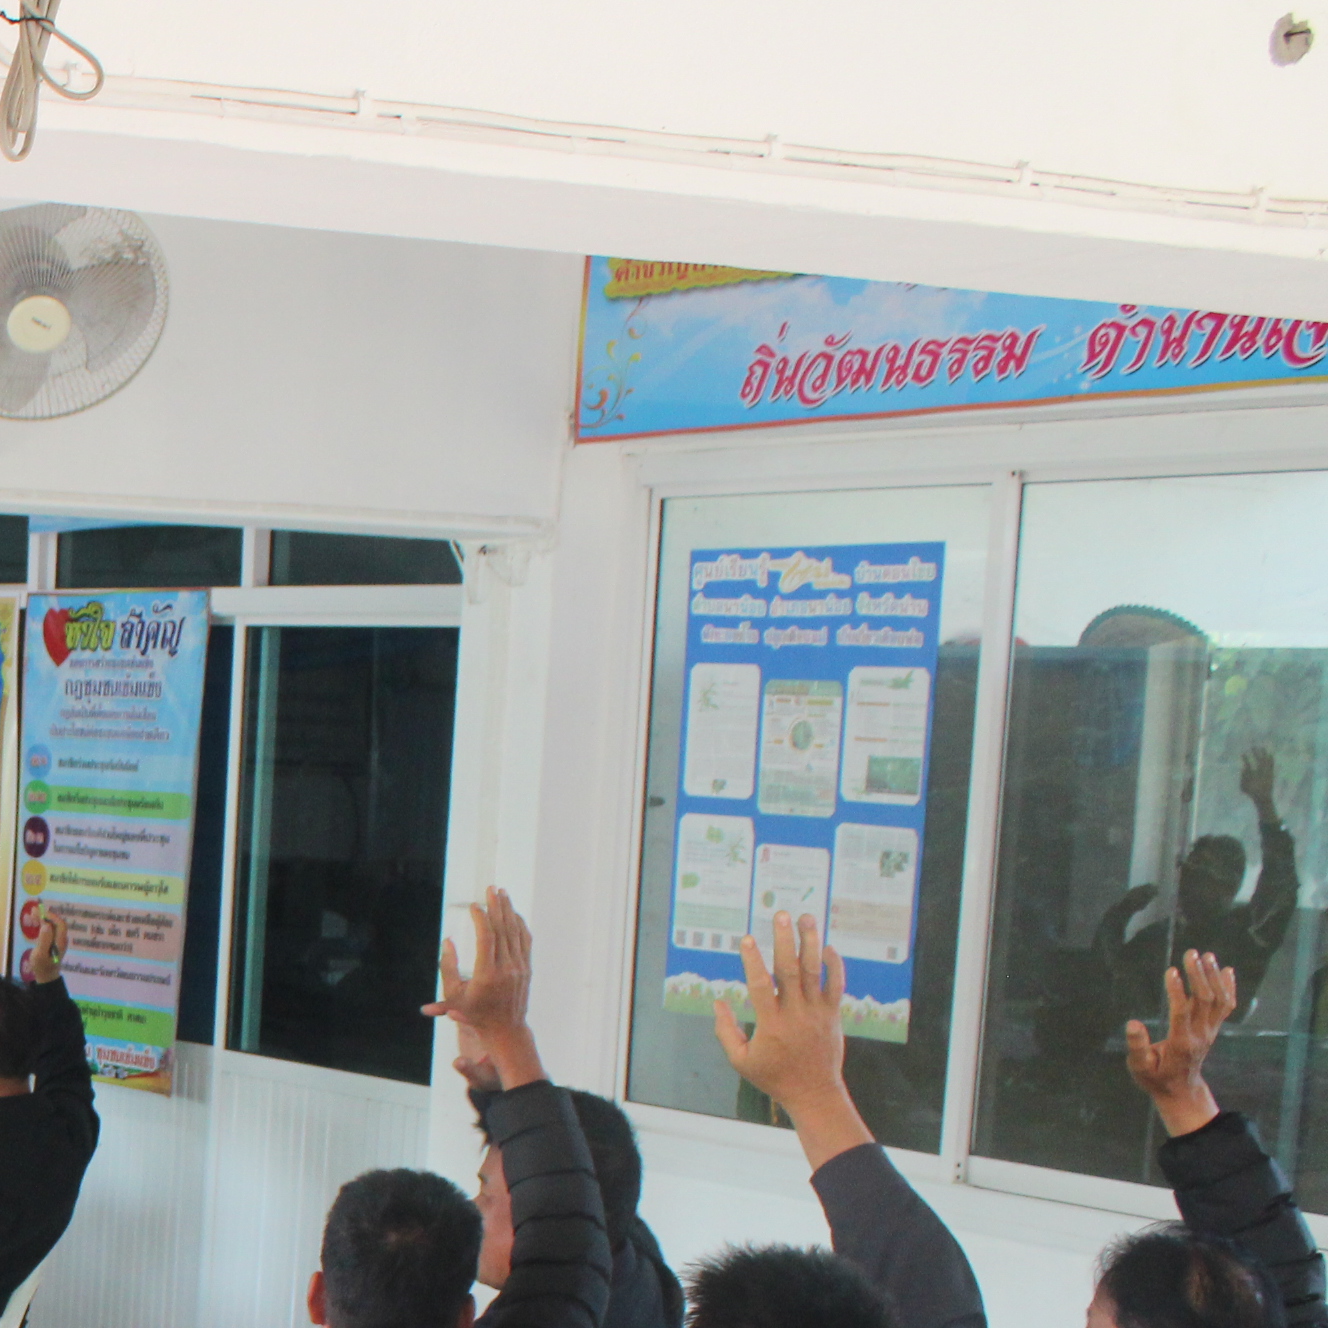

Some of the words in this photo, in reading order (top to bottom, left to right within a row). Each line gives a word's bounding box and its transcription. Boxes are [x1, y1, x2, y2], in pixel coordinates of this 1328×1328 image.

[740, 320, 1046, 408] ถิ่นวัฒนธรรม
